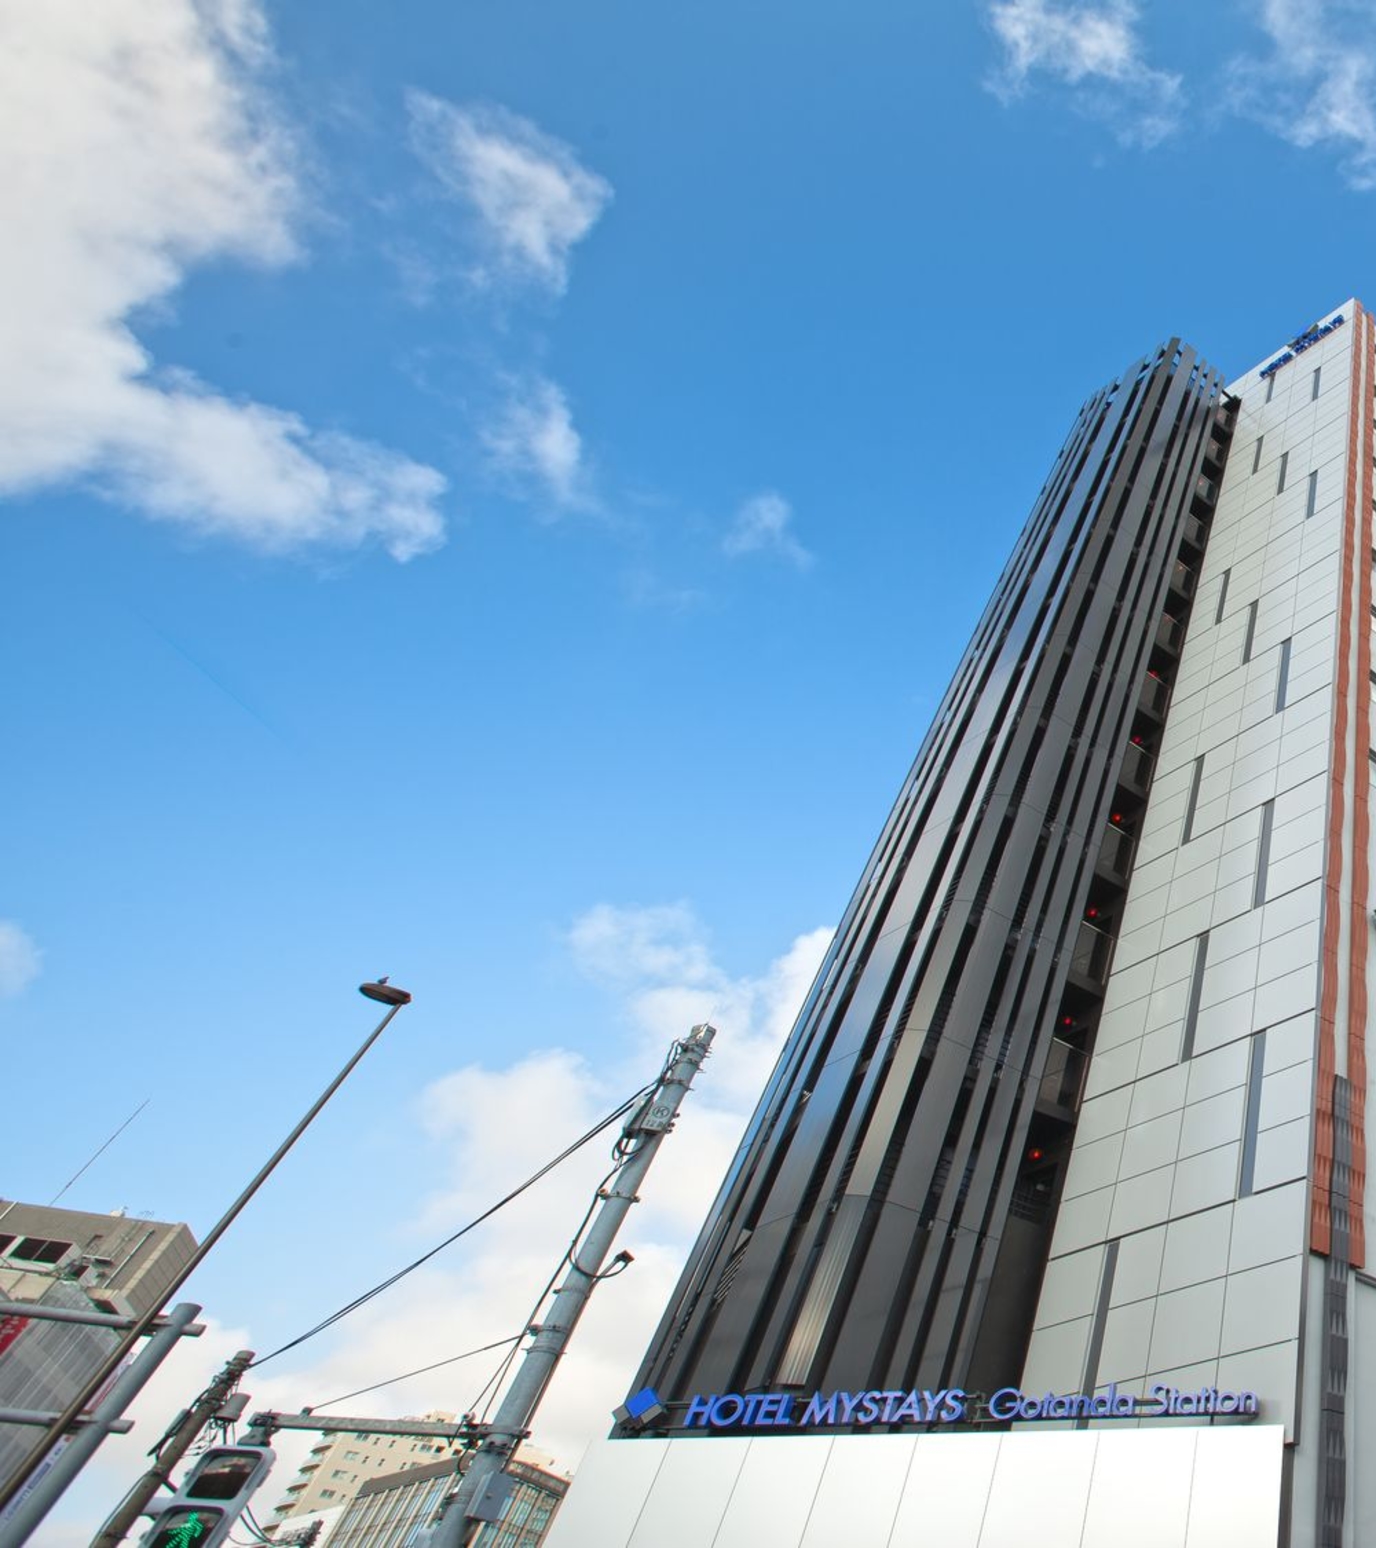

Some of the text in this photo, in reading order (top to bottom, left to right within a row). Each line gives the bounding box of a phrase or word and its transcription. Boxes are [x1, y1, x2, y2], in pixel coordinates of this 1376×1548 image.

[682, 1382, 1259, 1428] HOTEL MYSTAYS Gotanda Station
